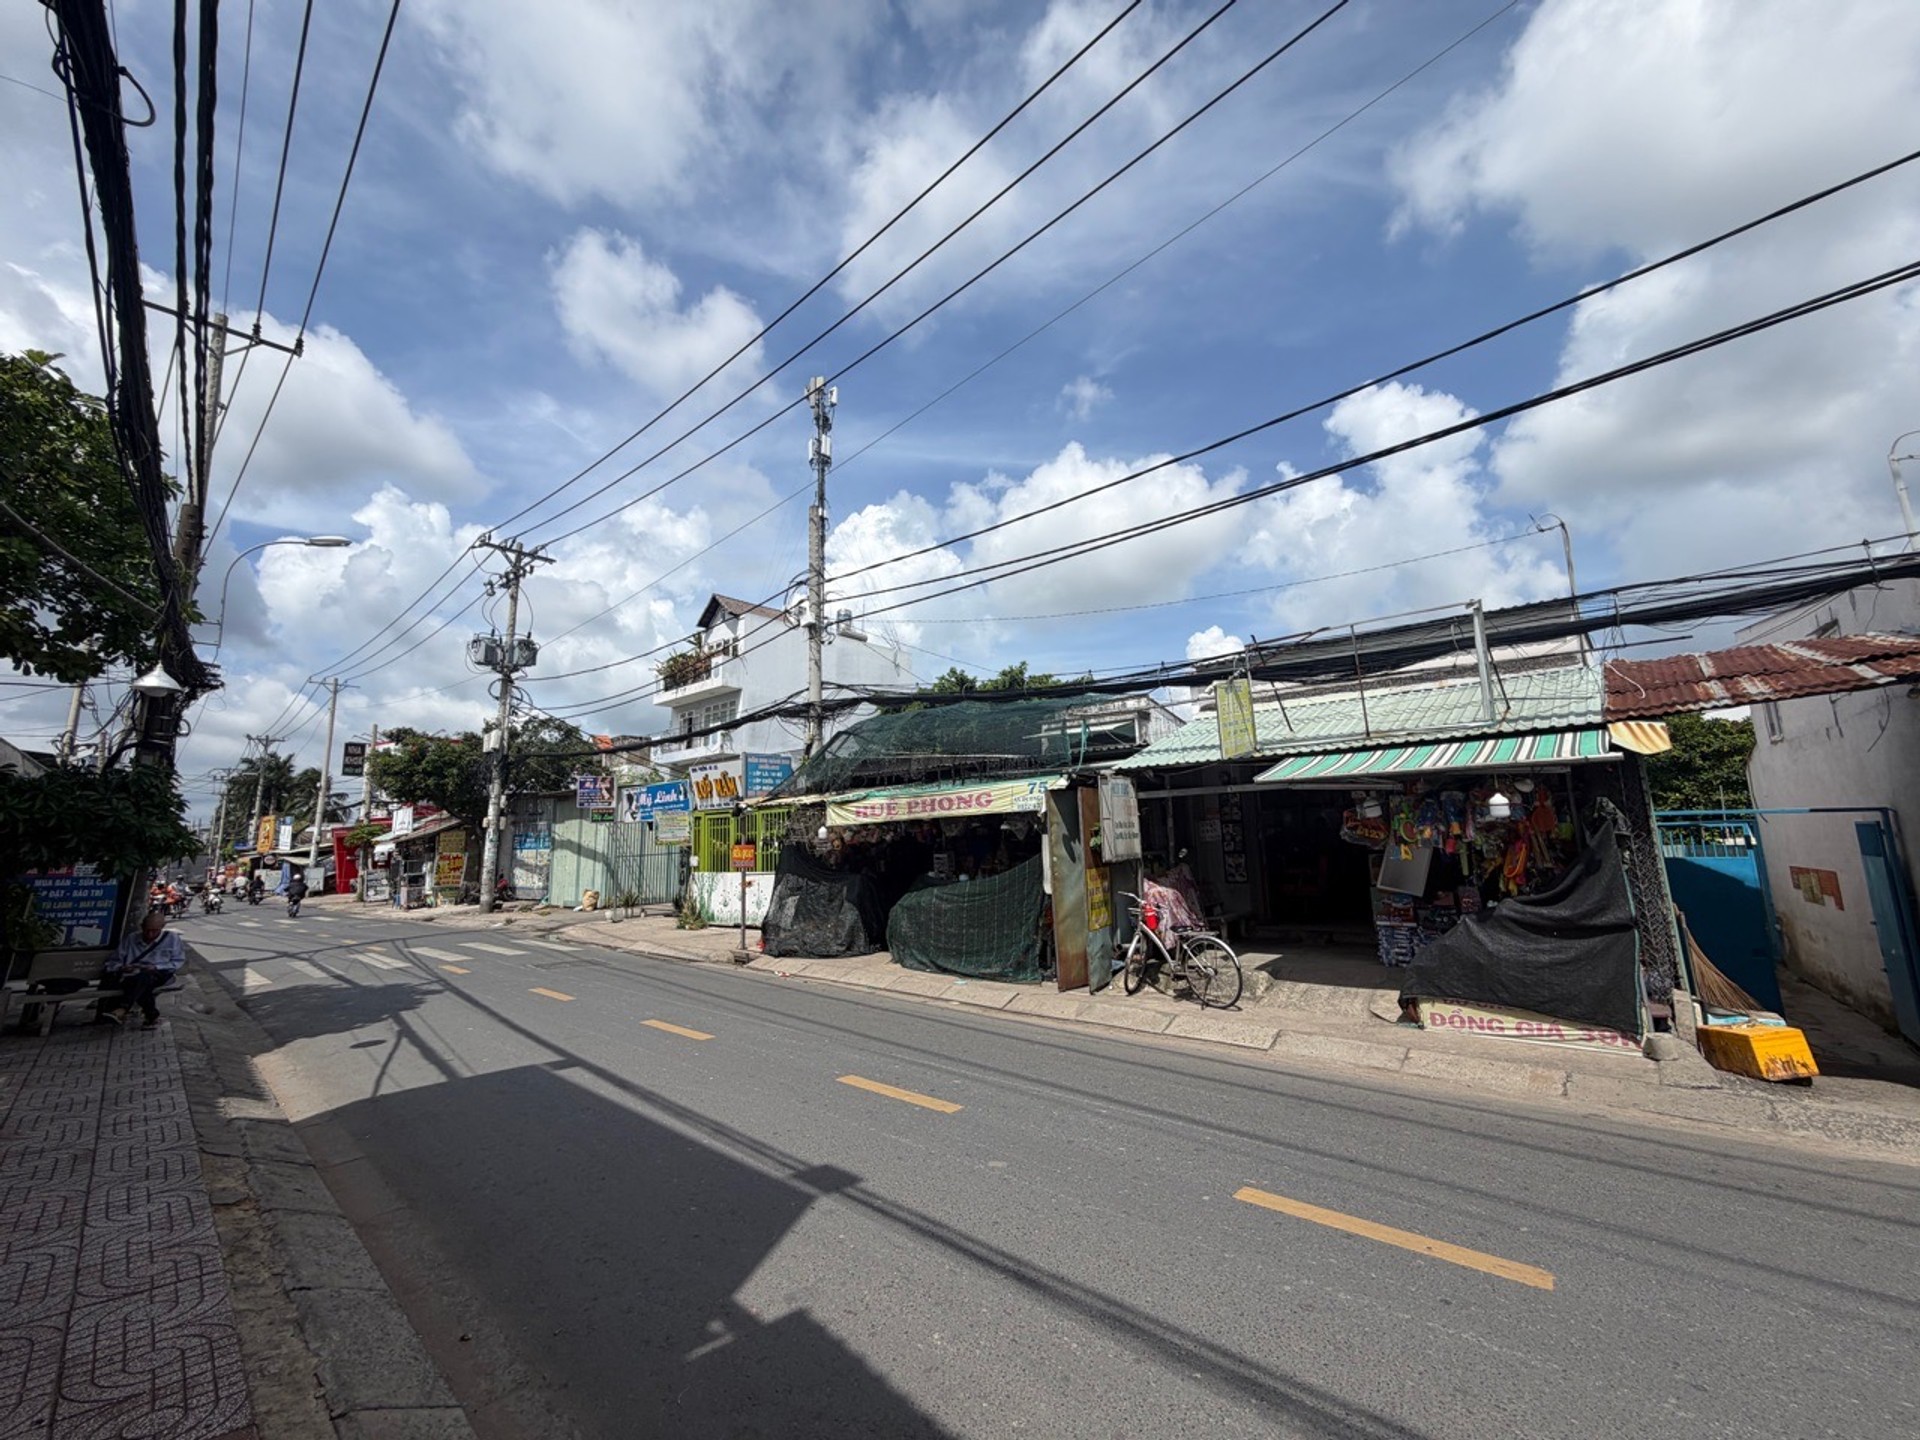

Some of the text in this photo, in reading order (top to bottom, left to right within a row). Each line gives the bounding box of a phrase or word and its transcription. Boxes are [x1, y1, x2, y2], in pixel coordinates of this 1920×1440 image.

[1027, 781, 1049, 795] 75
[905, 790, 993, 815] PHONG
[1429, 1008, 1505, 1033] ĐỒNG
